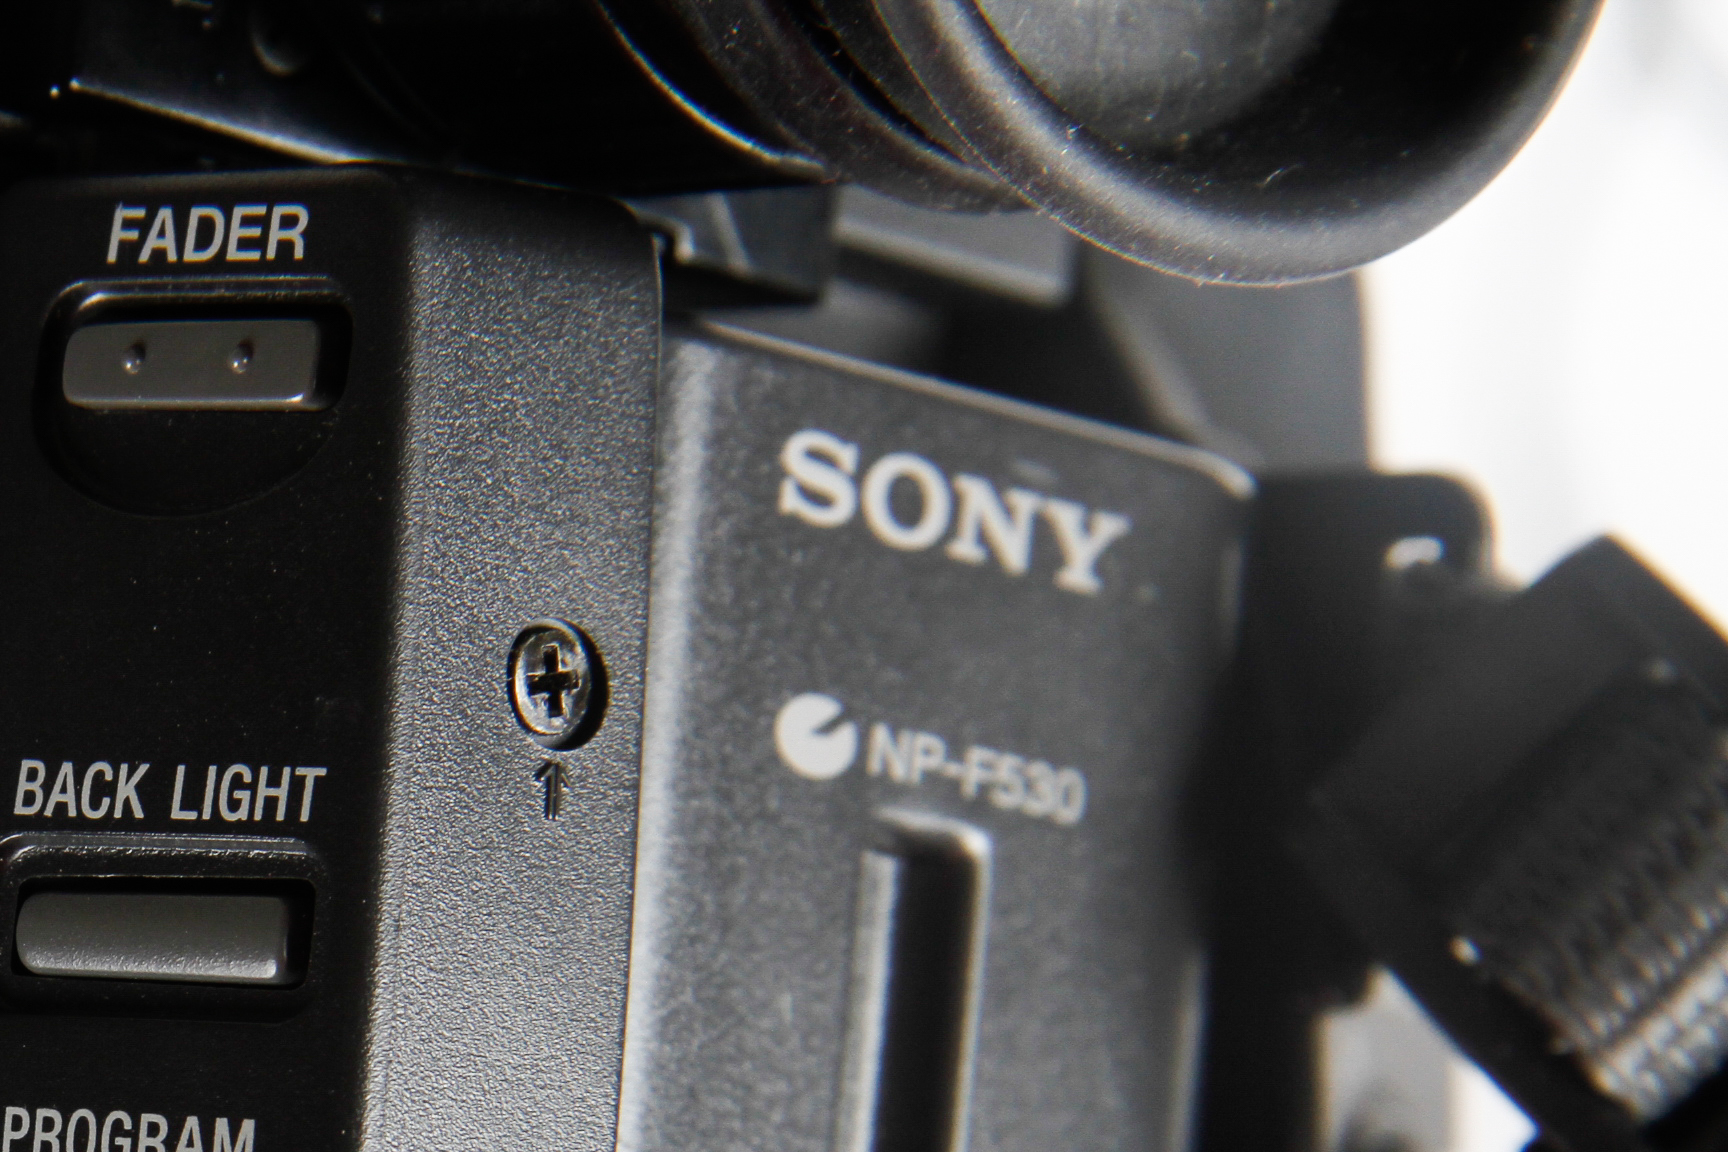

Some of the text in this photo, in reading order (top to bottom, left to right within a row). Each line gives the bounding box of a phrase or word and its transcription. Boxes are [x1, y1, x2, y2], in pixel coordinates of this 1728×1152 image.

[106, 204, 310, 264] FADER
[779, 428, 1132, 595] SONY
[13, 759, 327, 823] BACK LIGHT
[867, 722, 1088, 825] NP-F530
